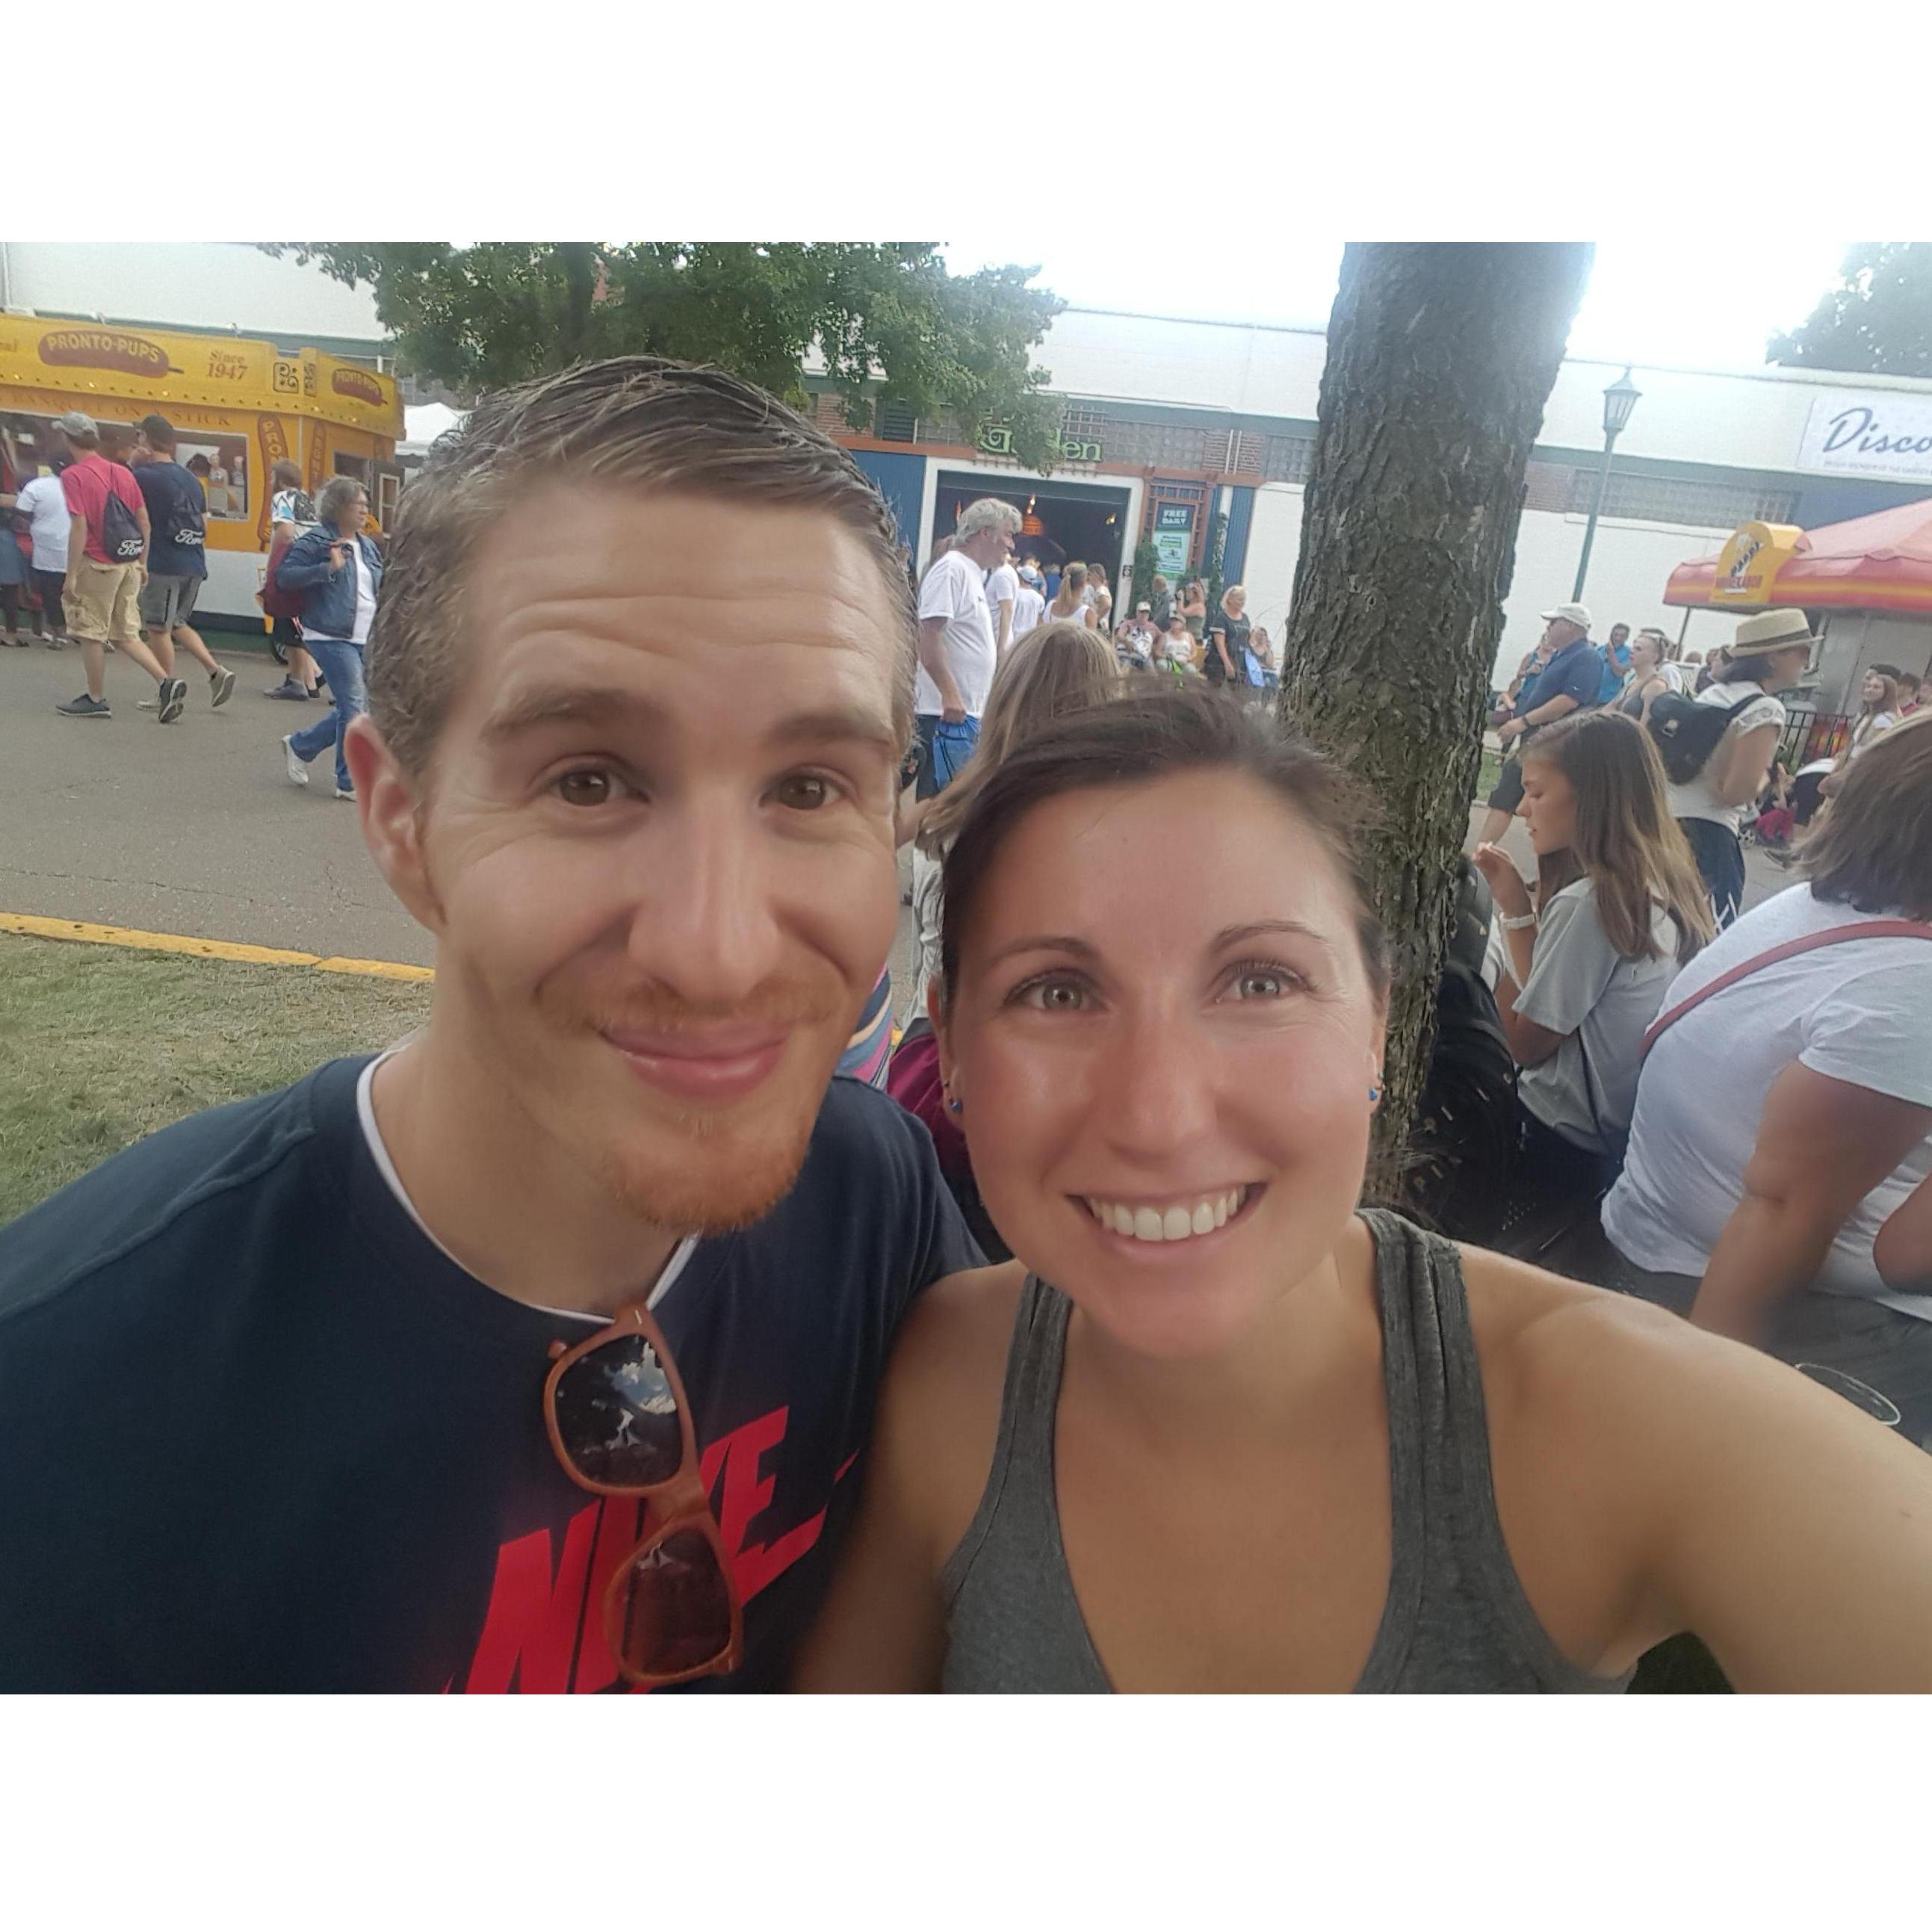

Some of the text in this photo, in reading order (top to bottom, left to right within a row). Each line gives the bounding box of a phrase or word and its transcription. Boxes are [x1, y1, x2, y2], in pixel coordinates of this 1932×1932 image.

[46, 333, 161, 363] PRONTO-PUPS
[208, 349, 245, 364] Since
[207, 362, 249, 380] 1947
[174, 410, 232, 427] STICK
[978, 415, 1103, 462] Gden
[174, 529, 204, 545] For
